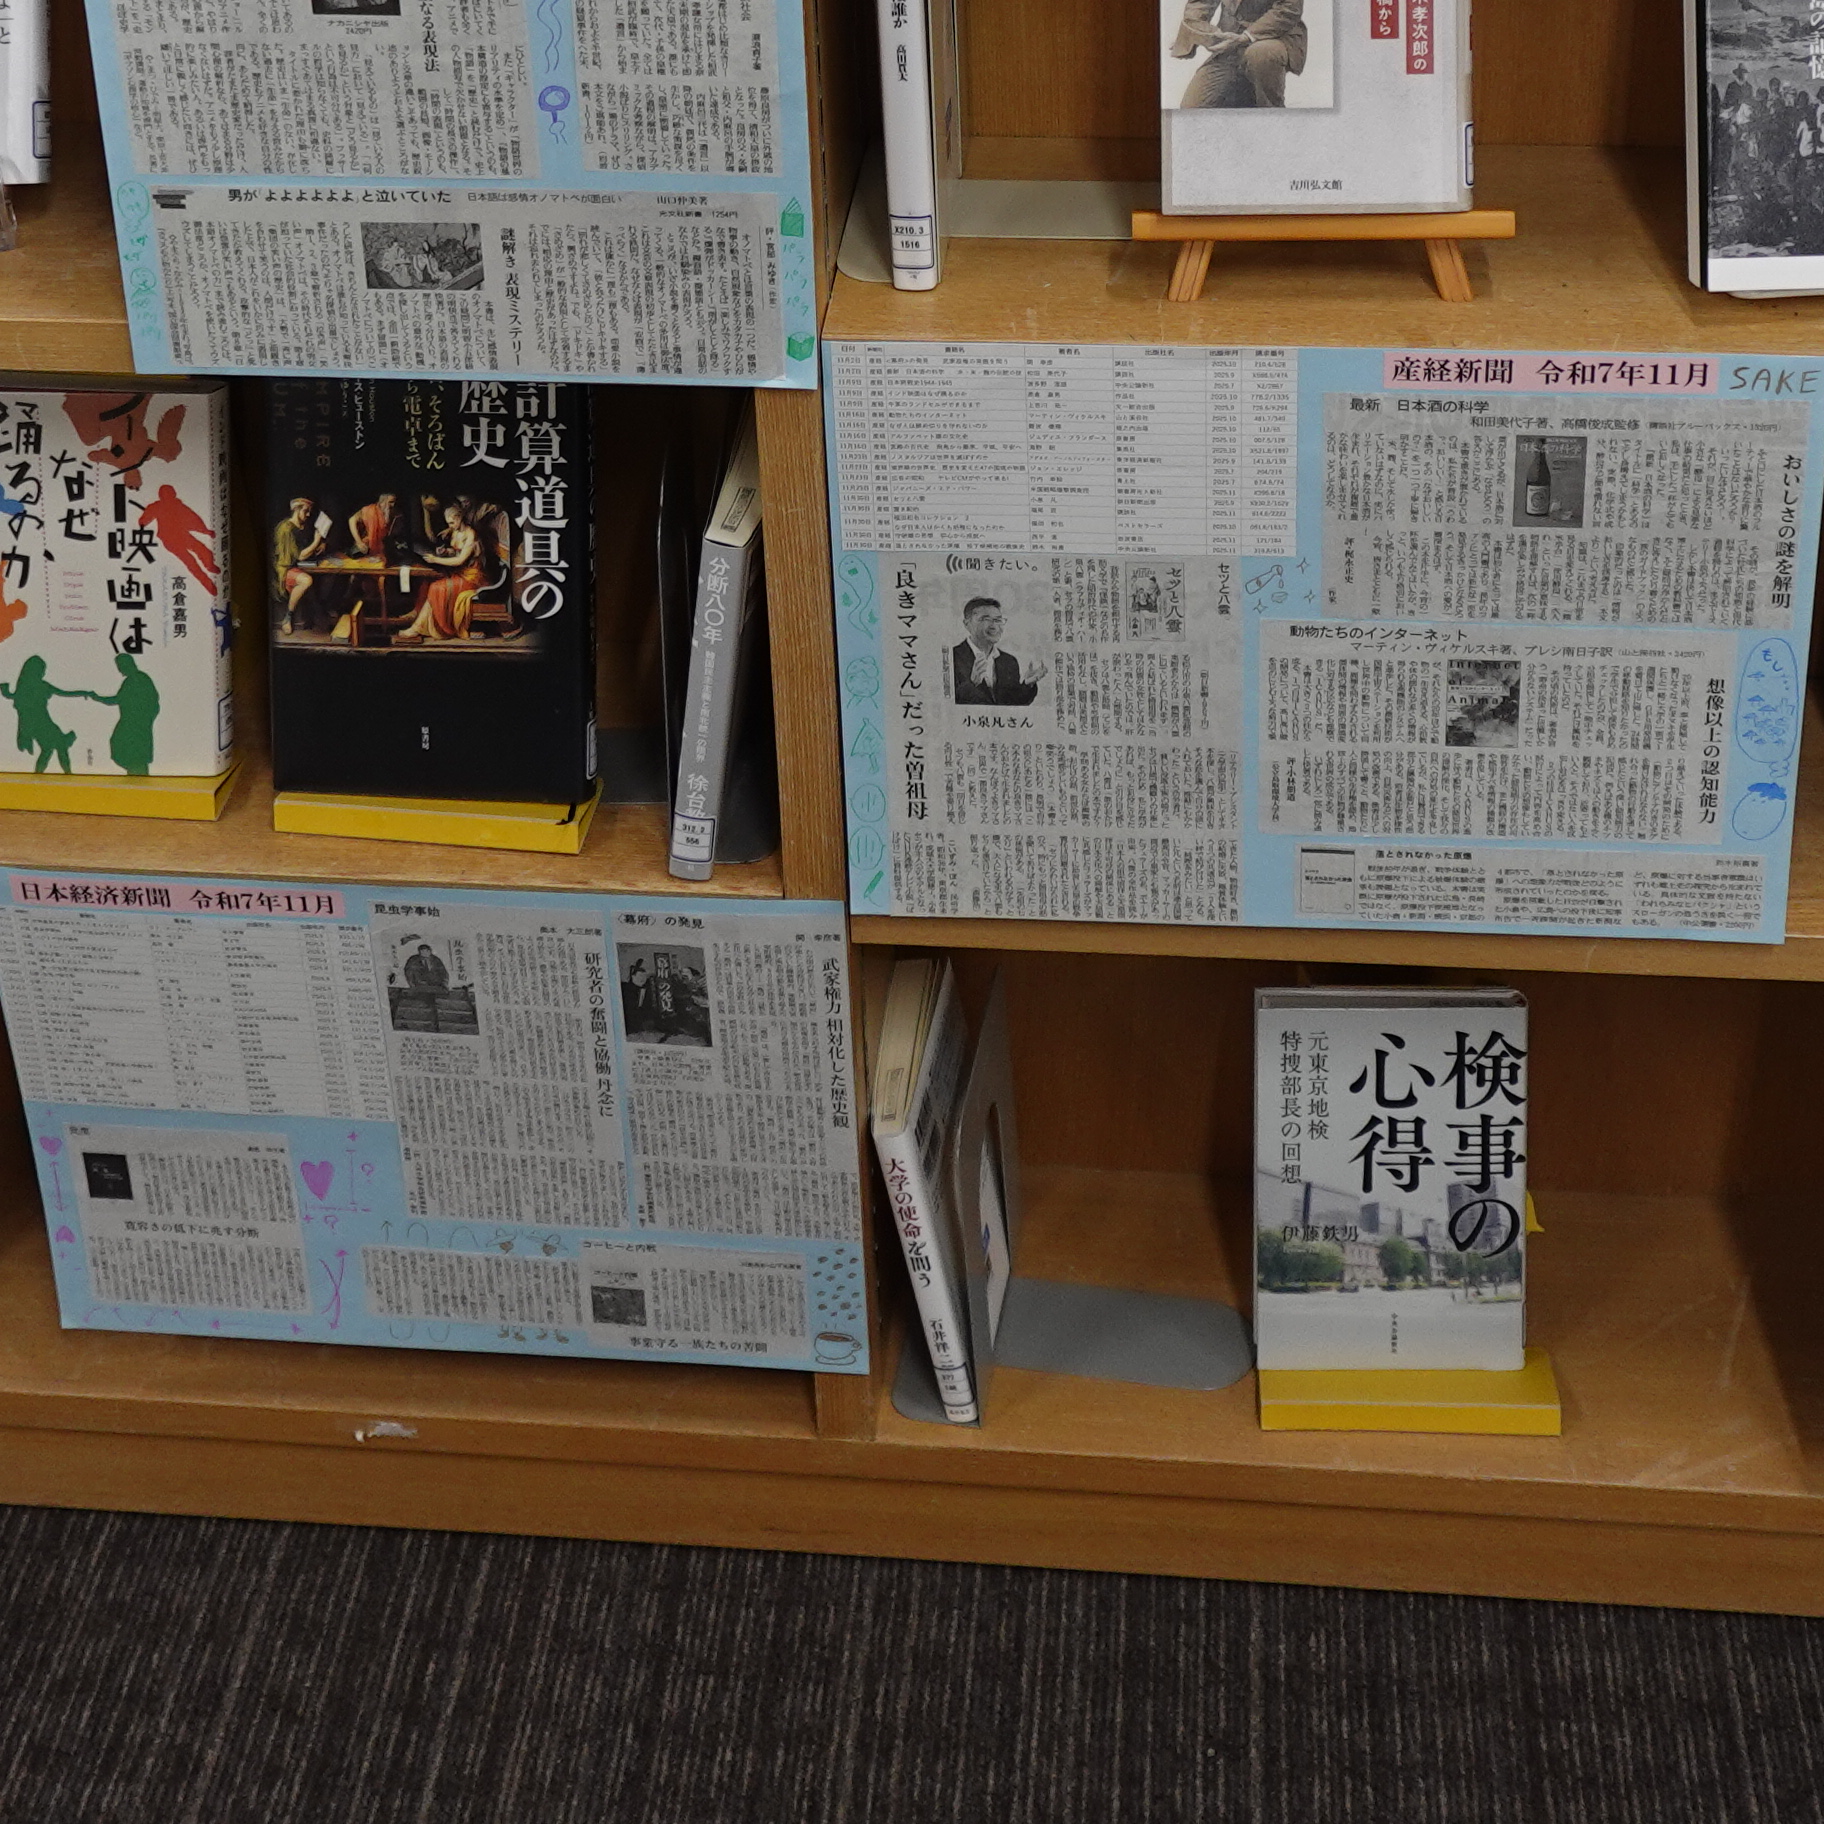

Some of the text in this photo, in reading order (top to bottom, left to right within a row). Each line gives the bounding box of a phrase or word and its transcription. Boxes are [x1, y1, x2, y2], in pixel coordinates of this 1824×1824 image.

[1288, 178, 1344, 192] 吉川弘文館
[894, 225, 925, 235] X210.3
[900, 240, 921, 249] 1516
[503, 272, 524, 369] 表現ミステリー
[1349, 398, 1490, 415] 最新 日本酒の科学
[1391, 356, 1714, 390] 産経新聞 令和7年11月
[1729, 363, 1819, 395] SAKE
[458, 381, 511, 469] 歴史
[49, 448, 101, 543] なぜ
[513, 382, 570, 621] 計算道具の
[1768, 451, 1804, 612] おいしさの謎を解明
[171, 575, 188, 639] 高倉嘉男
[701, 556, 731, 645] 分断八〇年
[1289, 624, 1469, 643] 動物たちのインターネット
[961, 714, 1034, 731] 小泉凡さん
[1697, 676, 1725, 826] 想像以上の認知能力
[19, 880, 336, 916] 日本経済新聞 令和7年11月
[373, 903, 441, 919] 昆虫学事始
[582, 951, 613, 1076] 研究者の奮闘と協働
[821, 955, 851, 1129] 武家権力 相対化した歴史観
[1279, 1030, 1303, 1185] 特捜部長の回想
[1307, 1030, 1330, 1142] 元東京地検
[1348, 1031, 1436, 1194] 心得
[1439, 1029, 1528, 1259] 検事の
[886, 1157, 932, 1289] 大学の使命を問う
[1281, 1223, 1359, 1243] 伊藤鉄男
